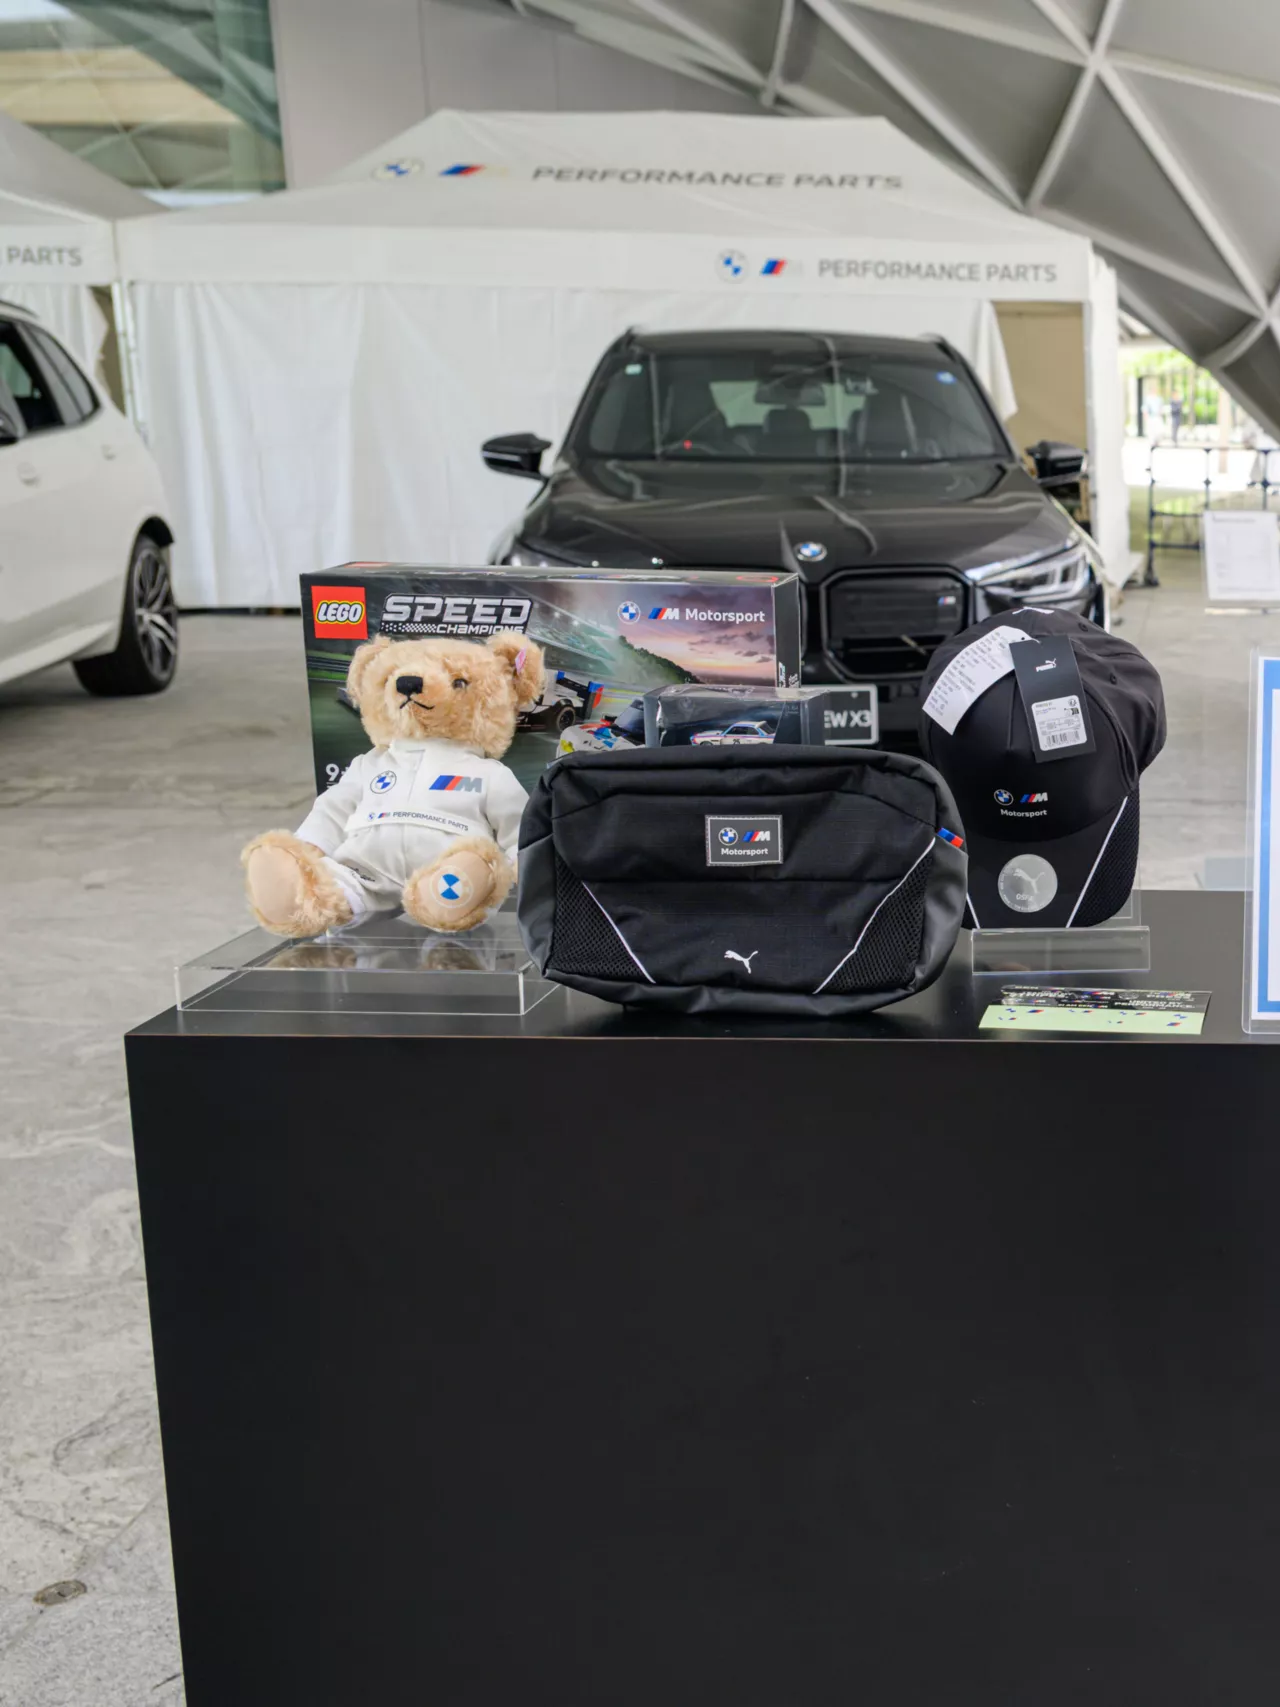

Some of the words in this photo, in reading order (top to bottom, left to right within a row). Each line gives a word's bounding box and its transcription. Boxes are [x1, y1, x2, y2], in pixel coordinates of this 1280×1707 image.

[532, 165, 786, 189] PERFORMANCE
[793, 173, 904, 190] PARTS
[6, 245, 83, 267] PARTS
[818, 259, 981, 282] PERFORMANCE
[986, 262, 1057, 284] PARTS
[317, 602, 362, 622] LEGO
[382, 596, 533, 625] SPEED
[685, 608, 765, 624] Motorsport
[824, 711, 849, 728] EW
[850, 711, 873, 727] X3
[392, 811, 447, 824] PERFORMANCE
[447, 820, 469, 831] PARTS
[1000, 809, 1047, 818] Motorsport
[721, 848, 768, 856] Motorsport
